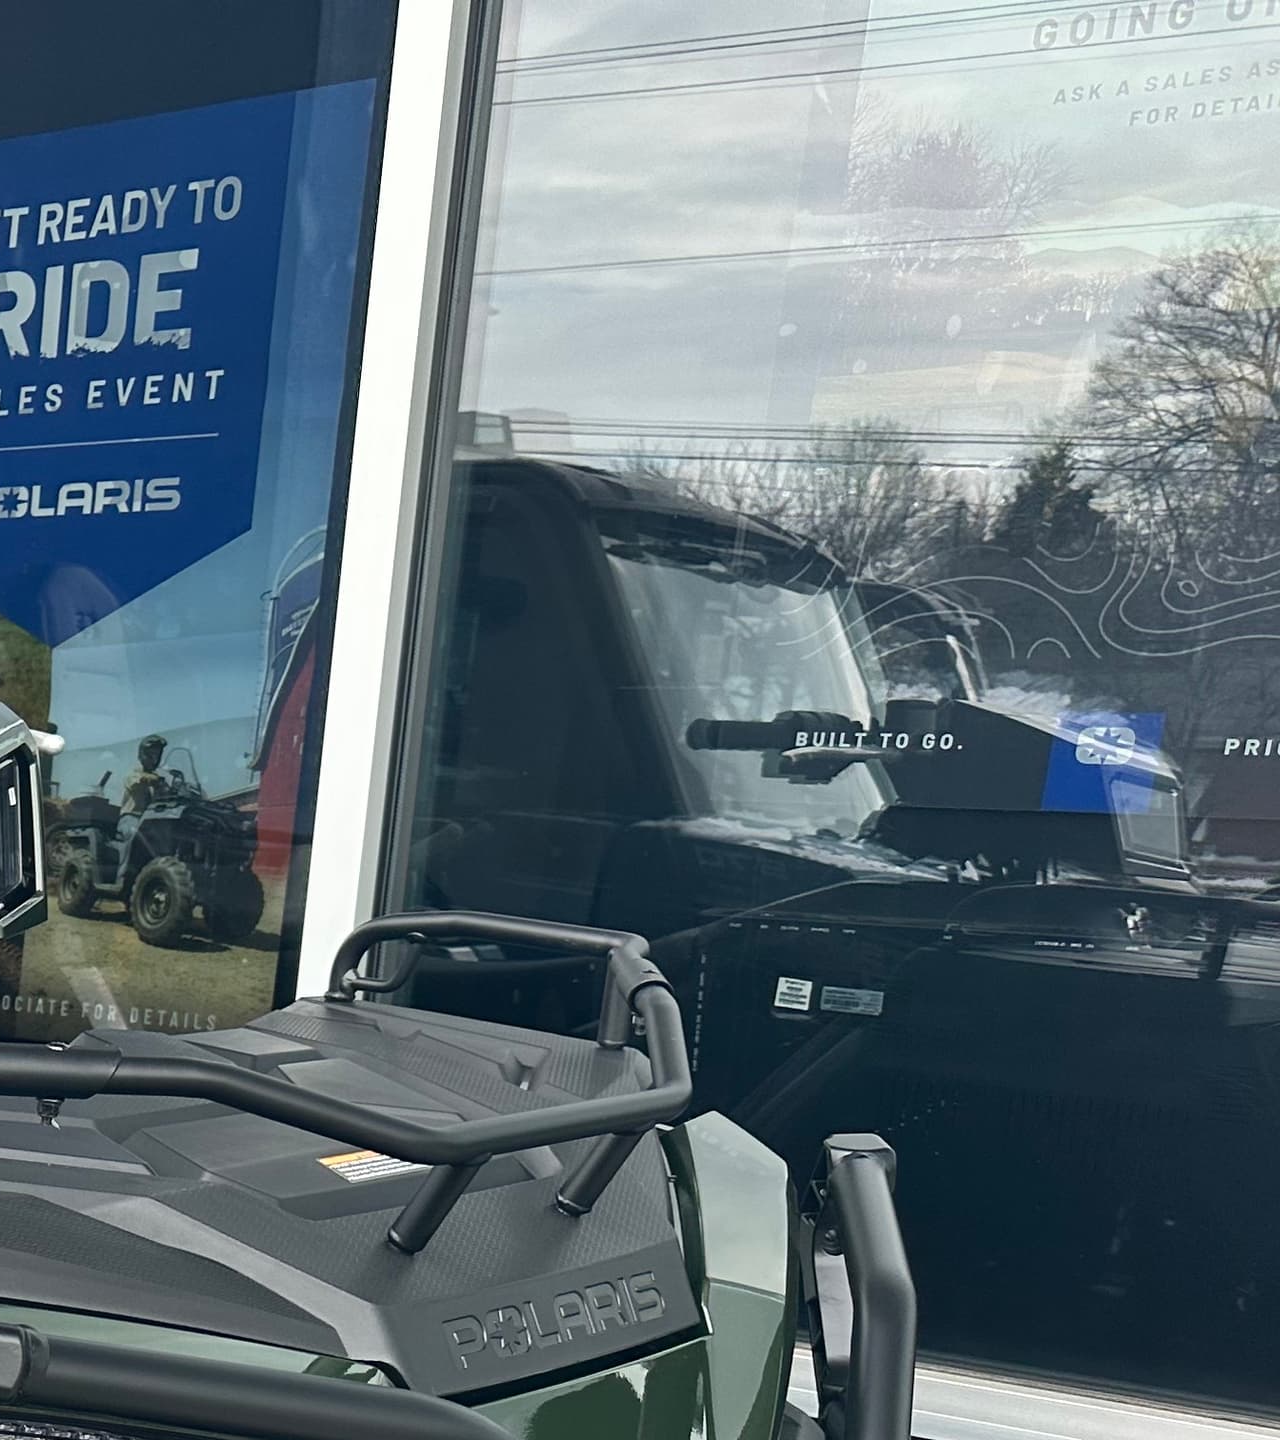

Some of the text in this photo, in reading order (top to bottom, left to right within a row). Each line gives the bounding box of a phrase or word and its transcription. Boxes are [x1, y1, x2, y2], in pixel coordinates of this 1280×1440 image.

[1033, 0, 1280, 50] GOING U
[1053, 58, 1280, 105] ASK A SALES AS
[1129, 93, 1280, 127] FOR DETAI
[37, 185, 177, 245] READY
[188, 176, 243, 224] TO
[87, 369, 225, 409] EVENT
[795, 731, 965, 751] BUILT TO GO.
[1223, 738, 1280, 756] PRI
[81, 1002, 116, 1022] FOR
[130, 1007, 217, 1031] DETAILS
[442, 1270, 665, 1369] POLARIS
